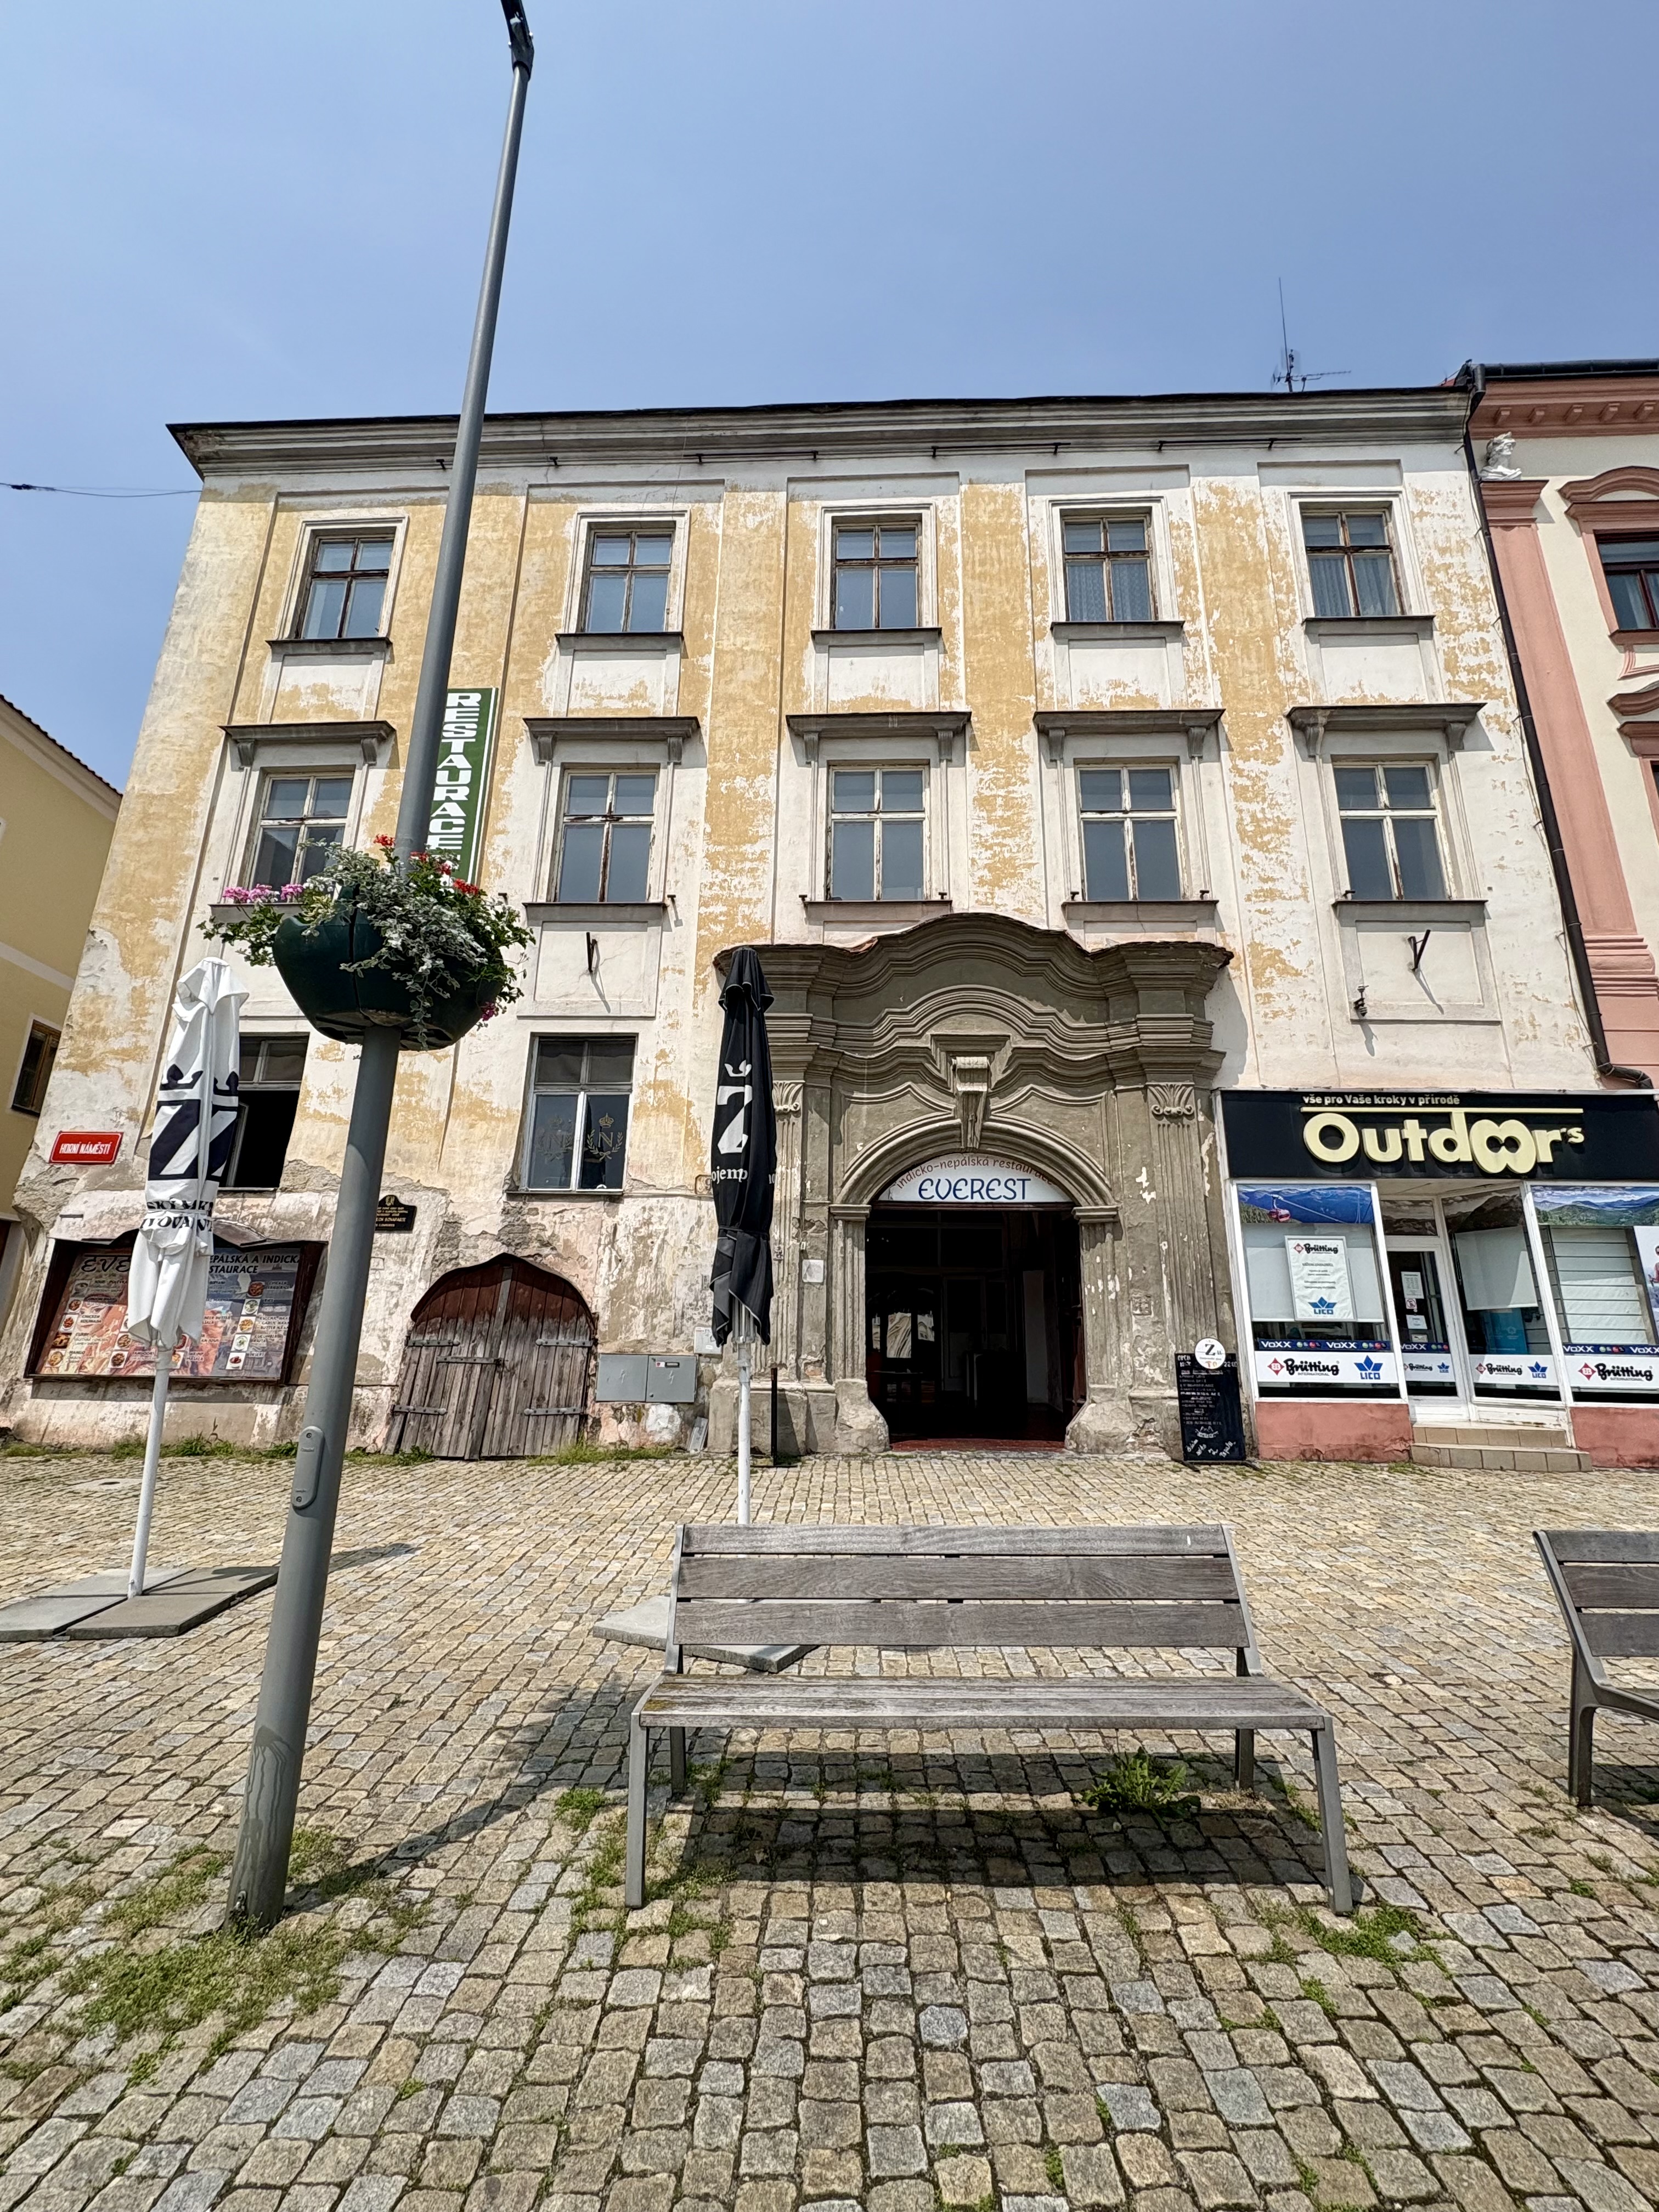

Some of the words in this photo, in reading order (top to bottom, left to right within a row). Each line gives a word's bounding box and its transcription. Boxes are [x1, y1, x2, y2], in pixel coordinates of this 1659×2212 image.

[426, 692, 481, 850] RESTAURACE
[1303, 1095, 1322, 1104] vše
[1324, 1097, 1343, 1105] pro
[1345, 1095, 1372, 1104] Vaše
[1374, 1095, 1406, 1106] kroky
[598, 1132, 614, 1148] N
[59, 1142, 81, 1154] HORNÍ
[79, 1141, 112, 1155] NÁMĚSTÍ
[918, 1178, 1031, 1200] EVEREST
[210, 1253, 248, 1263] EPÁLSKÁ
[250, 1255, 259, 1263] A
[208, 1265, 259, 1273] STAURACE
[1283, 1358, 1340, 1375] Brütting
[1595, 1363, 1654, 1381] Brütting
